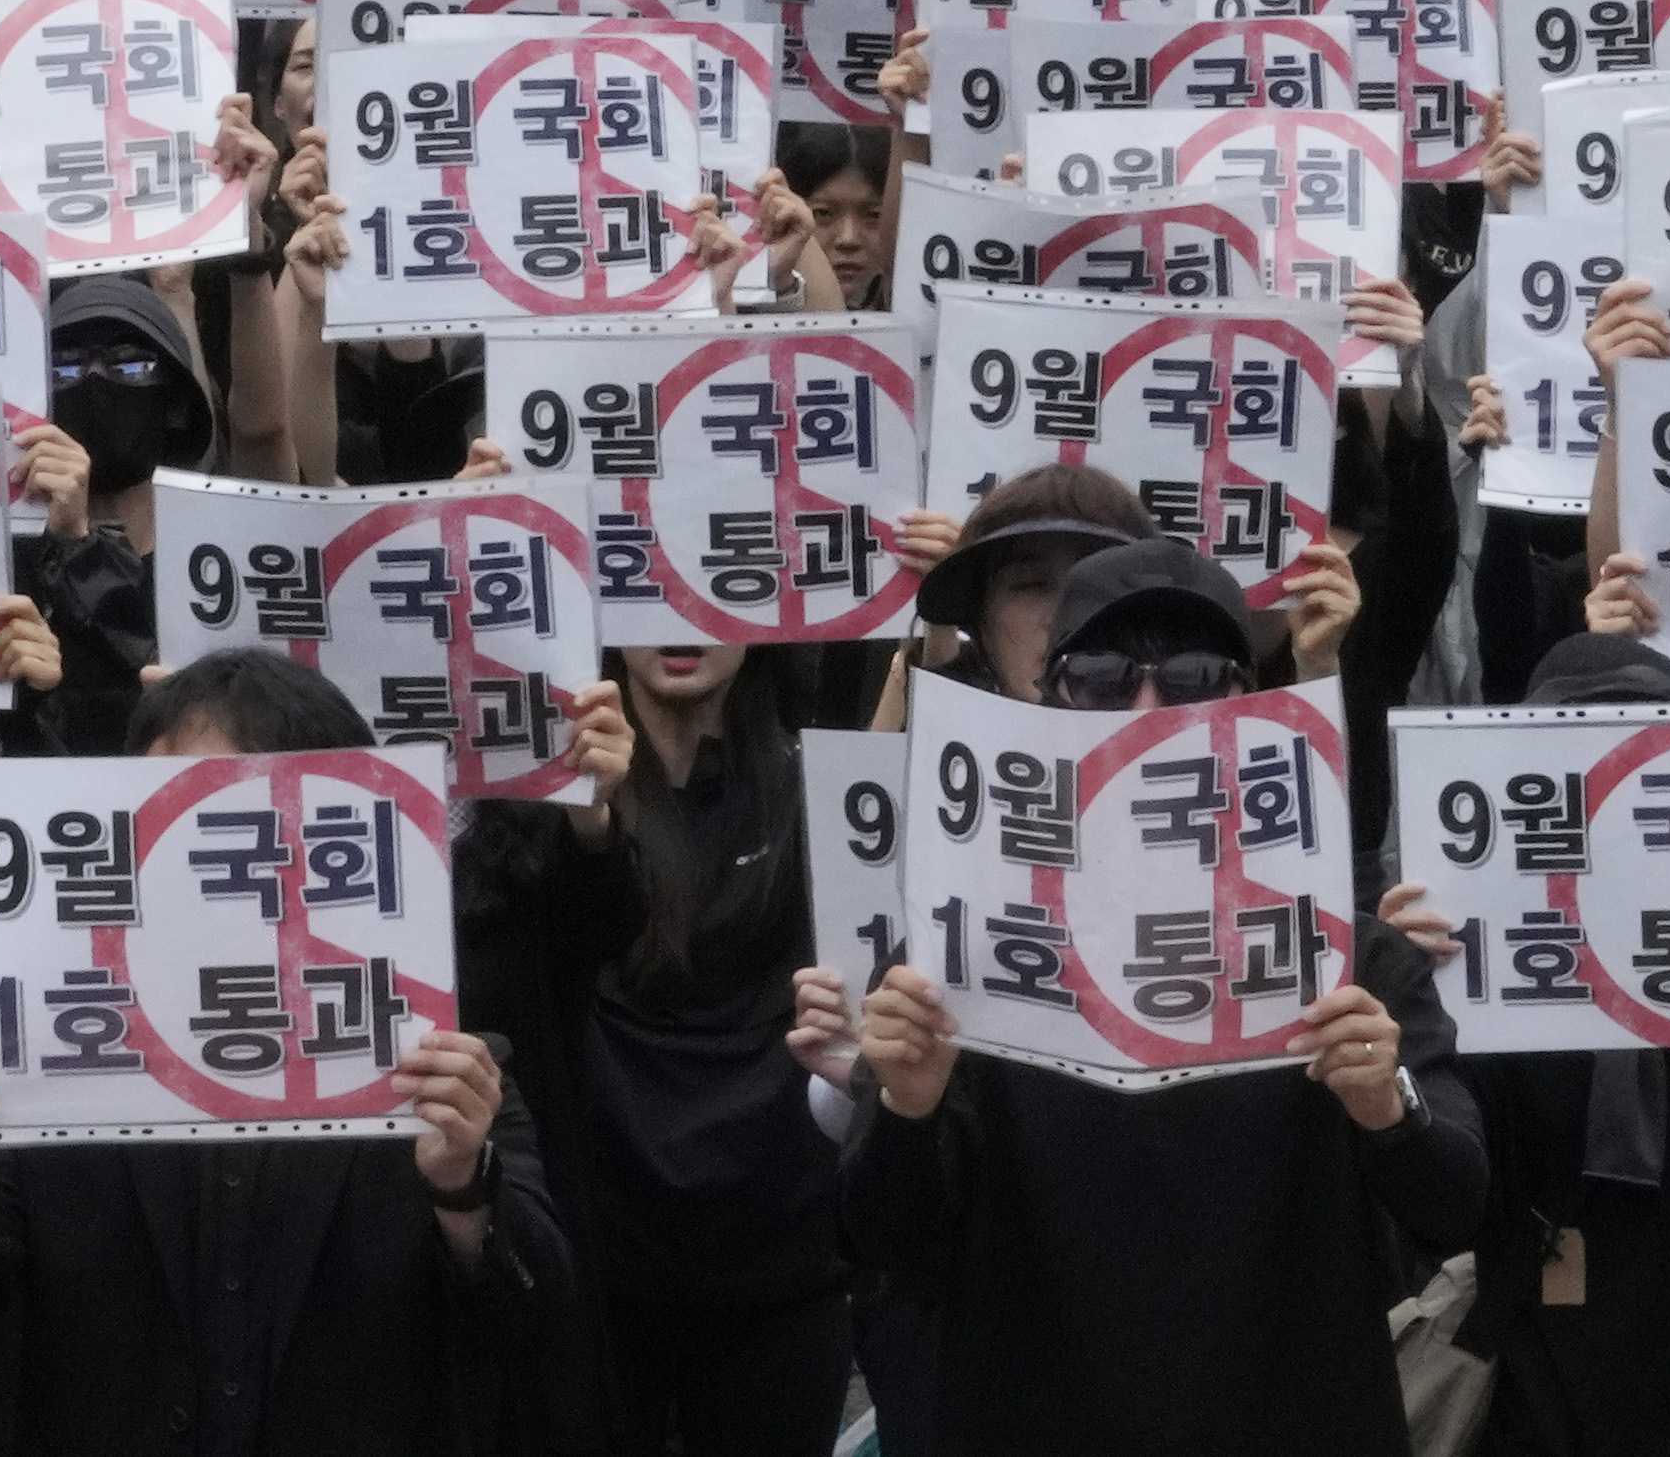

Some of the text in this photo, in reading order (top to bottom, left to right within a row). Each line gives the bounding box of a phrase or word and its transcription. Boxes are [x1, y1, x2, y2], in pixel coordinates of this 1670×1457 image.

[36, 20, 202, 100] 국회
[356, 75, 667, 169] 9월 국회
[39, 131, 210, 228] 통과
[361, 190, 672, 281] 1호 통과
[521, 373, 877, 482] 9월 국회
[703, 504, 886, 604] 통과
[935, 736, 1318, 866] 9월 국회
[1436, 771, 1592, 873] 9월
[185, 797, 402, 914] 국회
[932, 895, 1335, 1021] 1호 통과
[1449, 908, 1592, 1005] 1호
[190, 956, 412, 1074] 통과
